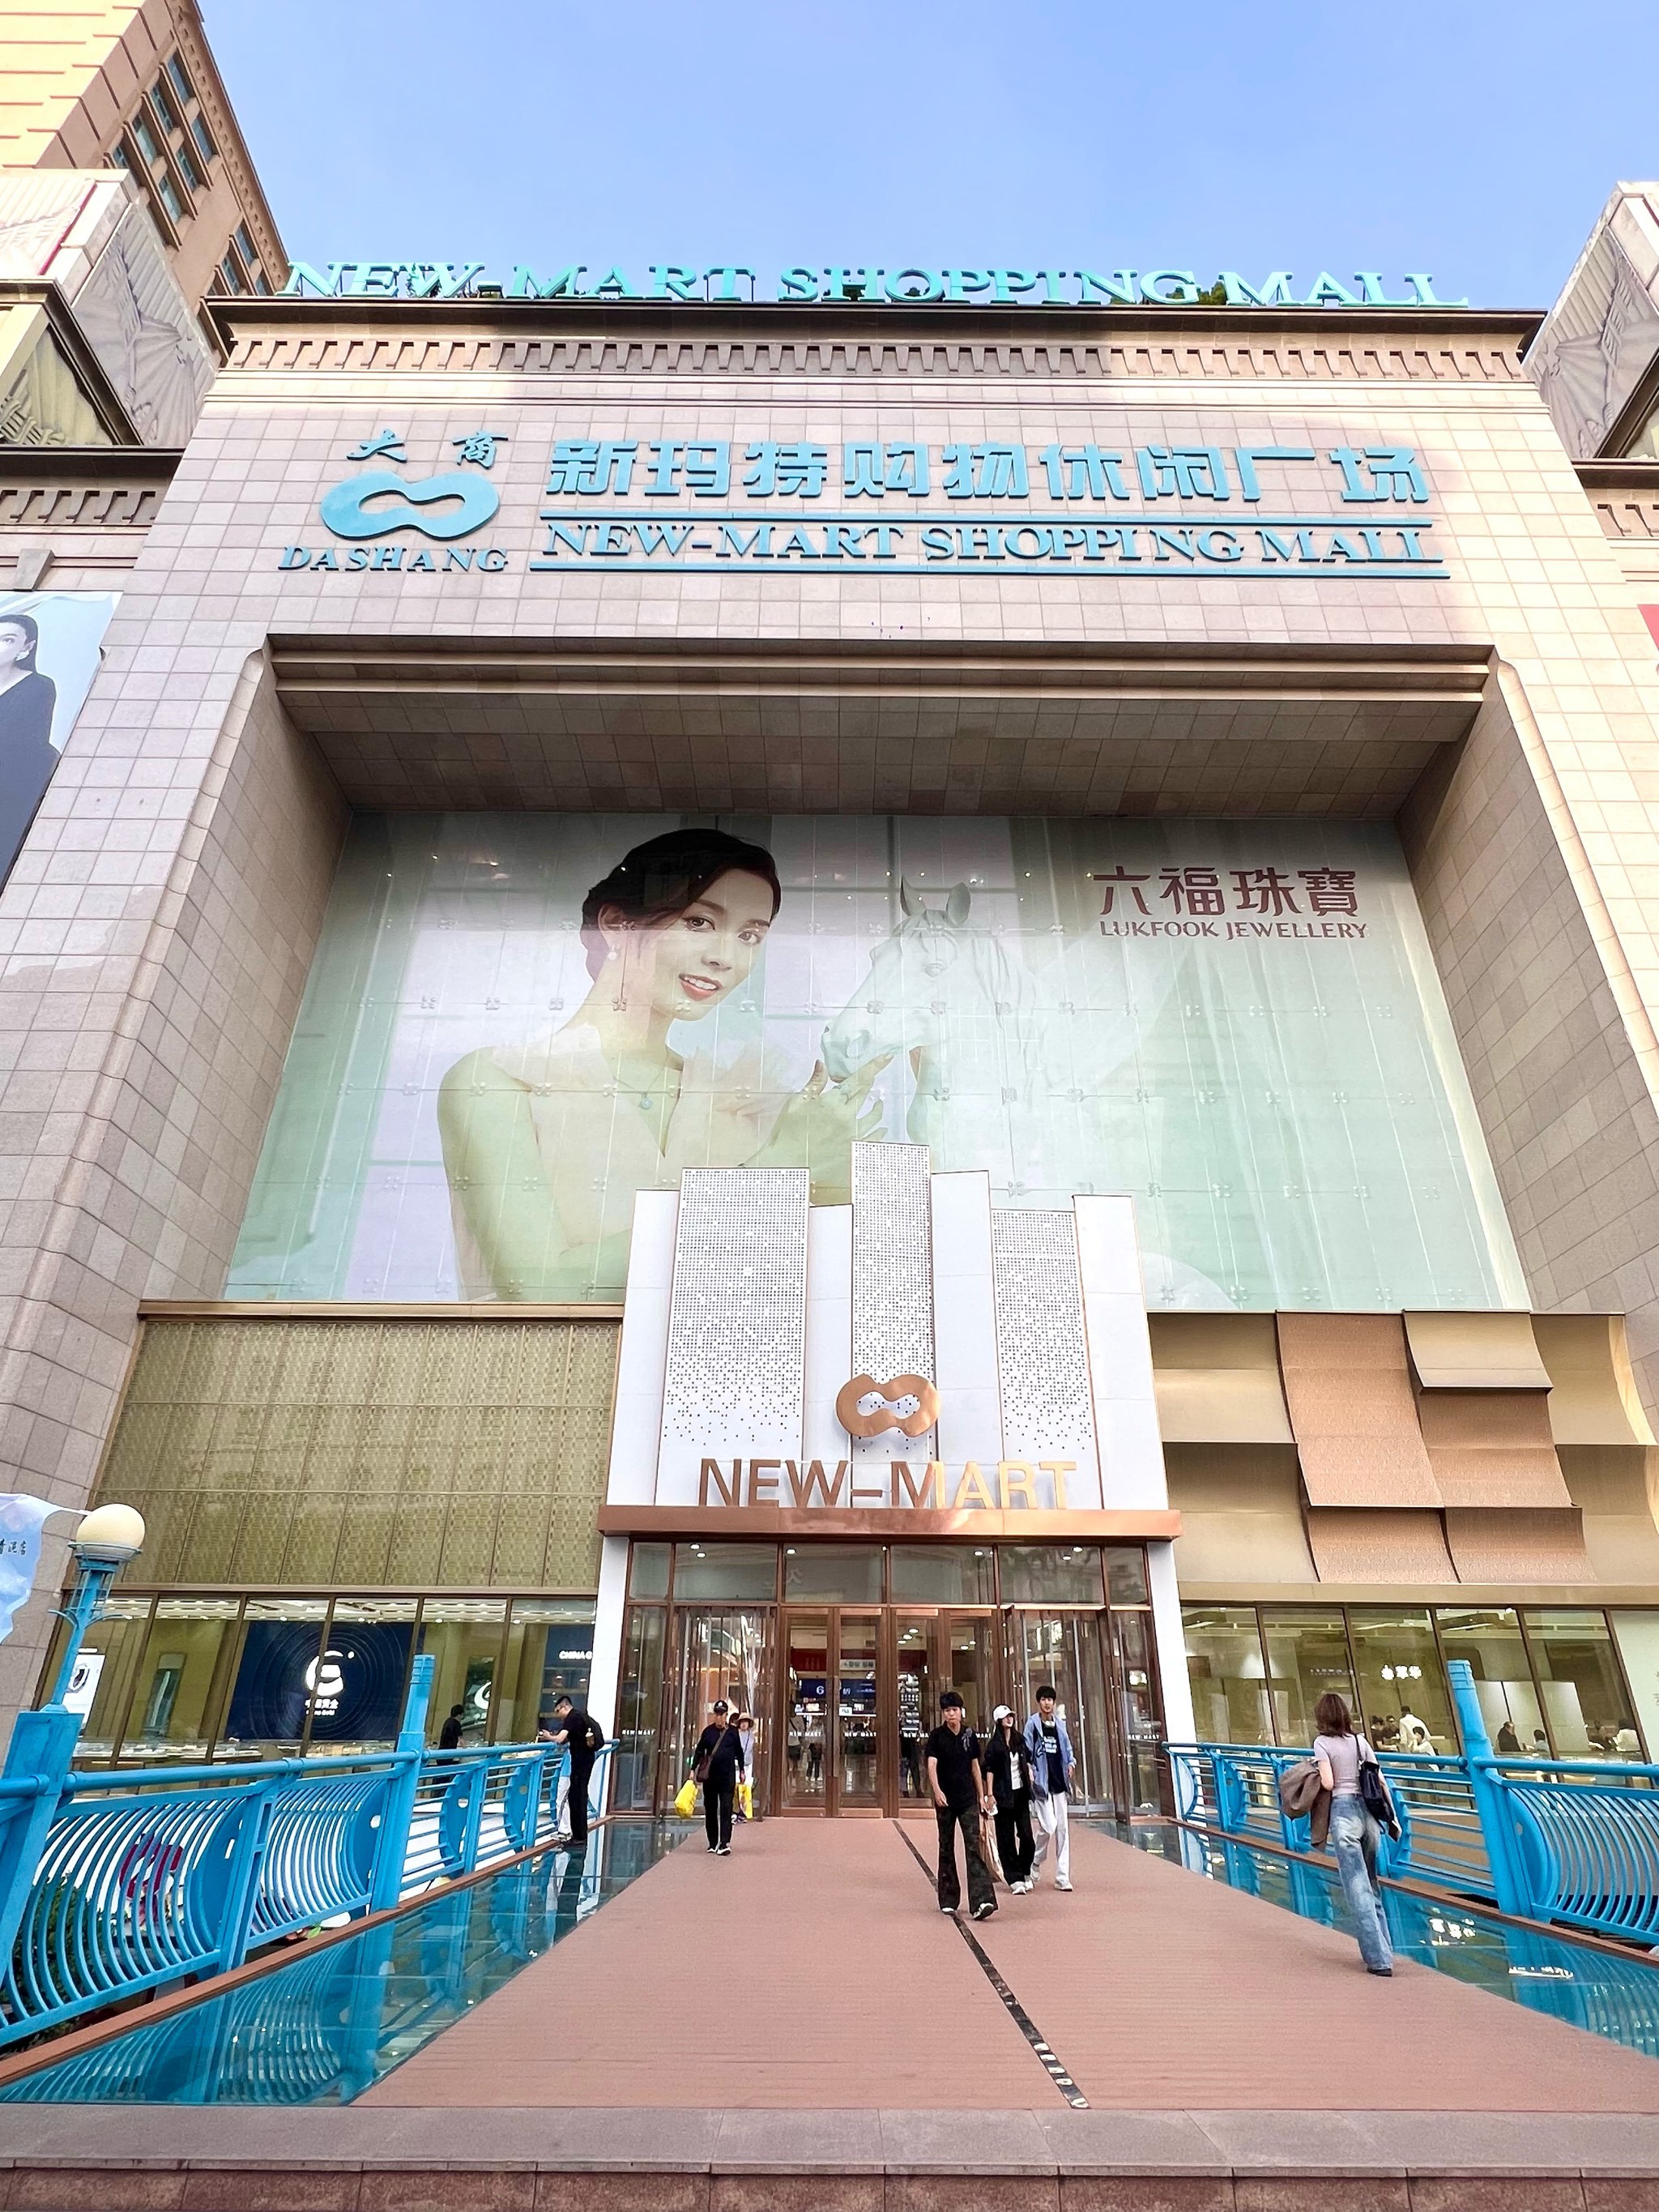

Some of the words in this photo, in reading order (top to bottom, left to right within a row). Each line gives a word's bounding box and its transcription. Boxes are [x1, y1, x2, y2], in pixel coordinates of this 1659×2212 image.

[275, 261, 757, 301] NEW-MART
[778, 267, 1201, 305] SHOPPING
[1216, 271, 1469, 307] MALL
[346, 429, 508, 469] 大商
[545, 439, 1430, 502] 新玛特购物休闲广场
[278, 545, 509, 572] DASHANG
[542, 523, 904, 559] NEW-MART
[921, 527, 1244, 562] SHOPPING
[1256, 530, 1444, 563] MALL
[1093, 865, 1358, 917] 六福珠寶
[1099, 920, 1219, 937] LUKFOOK
[1226, 922, 1367, 941] JEWELLERY
[698, 1458, 1077, 1510] NEW-MART
